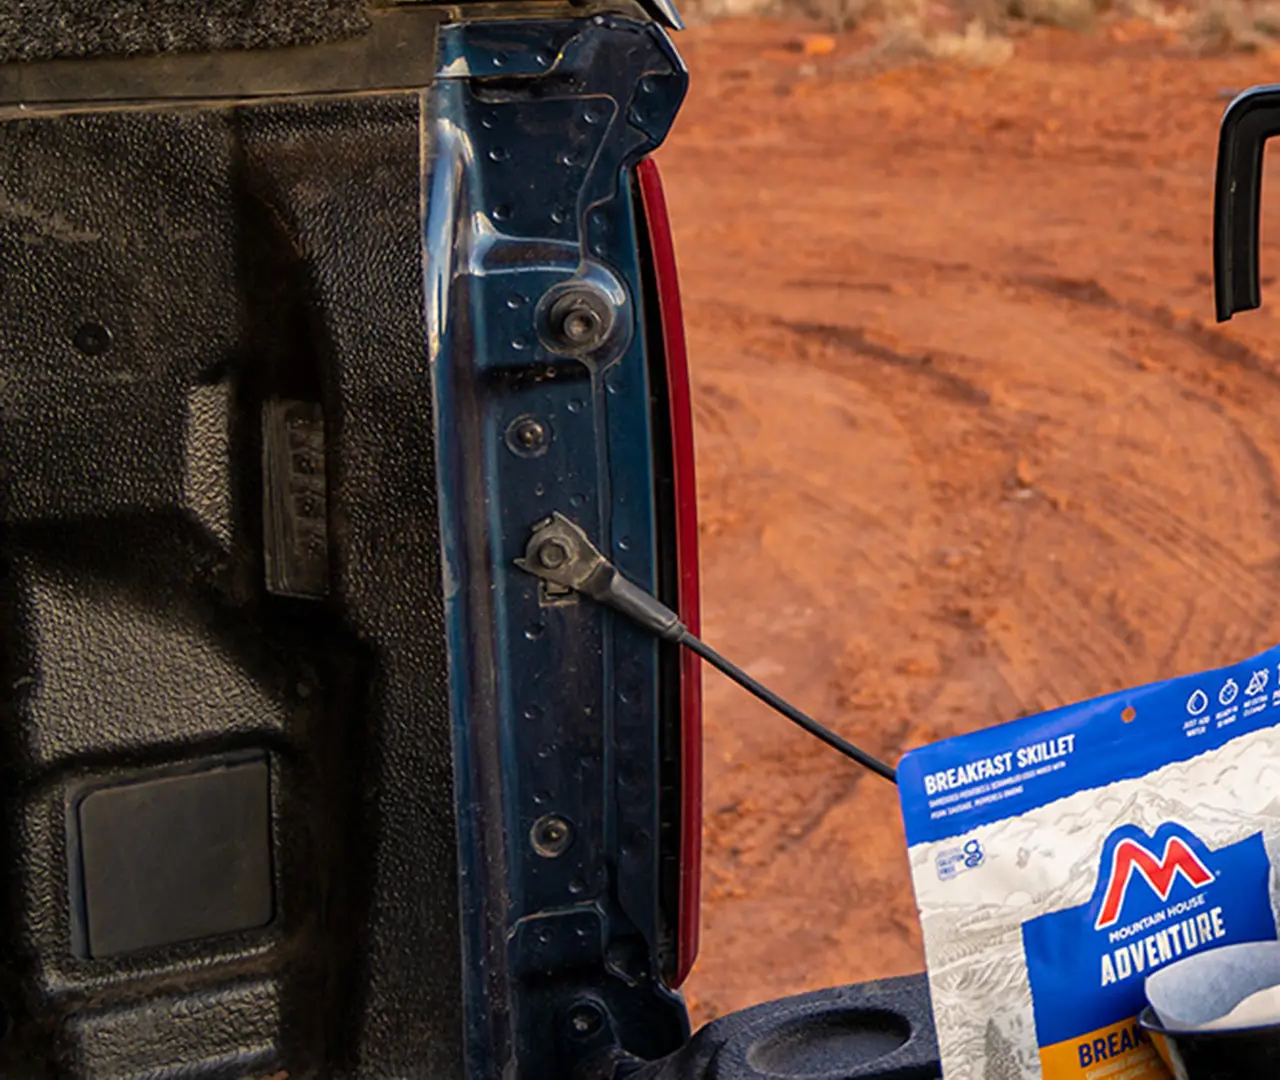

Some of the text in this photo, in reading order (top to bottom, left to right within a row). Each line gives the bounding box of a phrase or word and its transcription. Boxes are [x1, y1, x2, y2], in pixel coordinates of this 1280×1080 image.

[923, 751, 1014, 796] BREAKFAST
[1016, 733, 1076, 769] SKILLET
[1101, 906, 1226, 987] ADVENTURE
[1108, 894, 1206, 944] MOUNTAIN HOUSE
